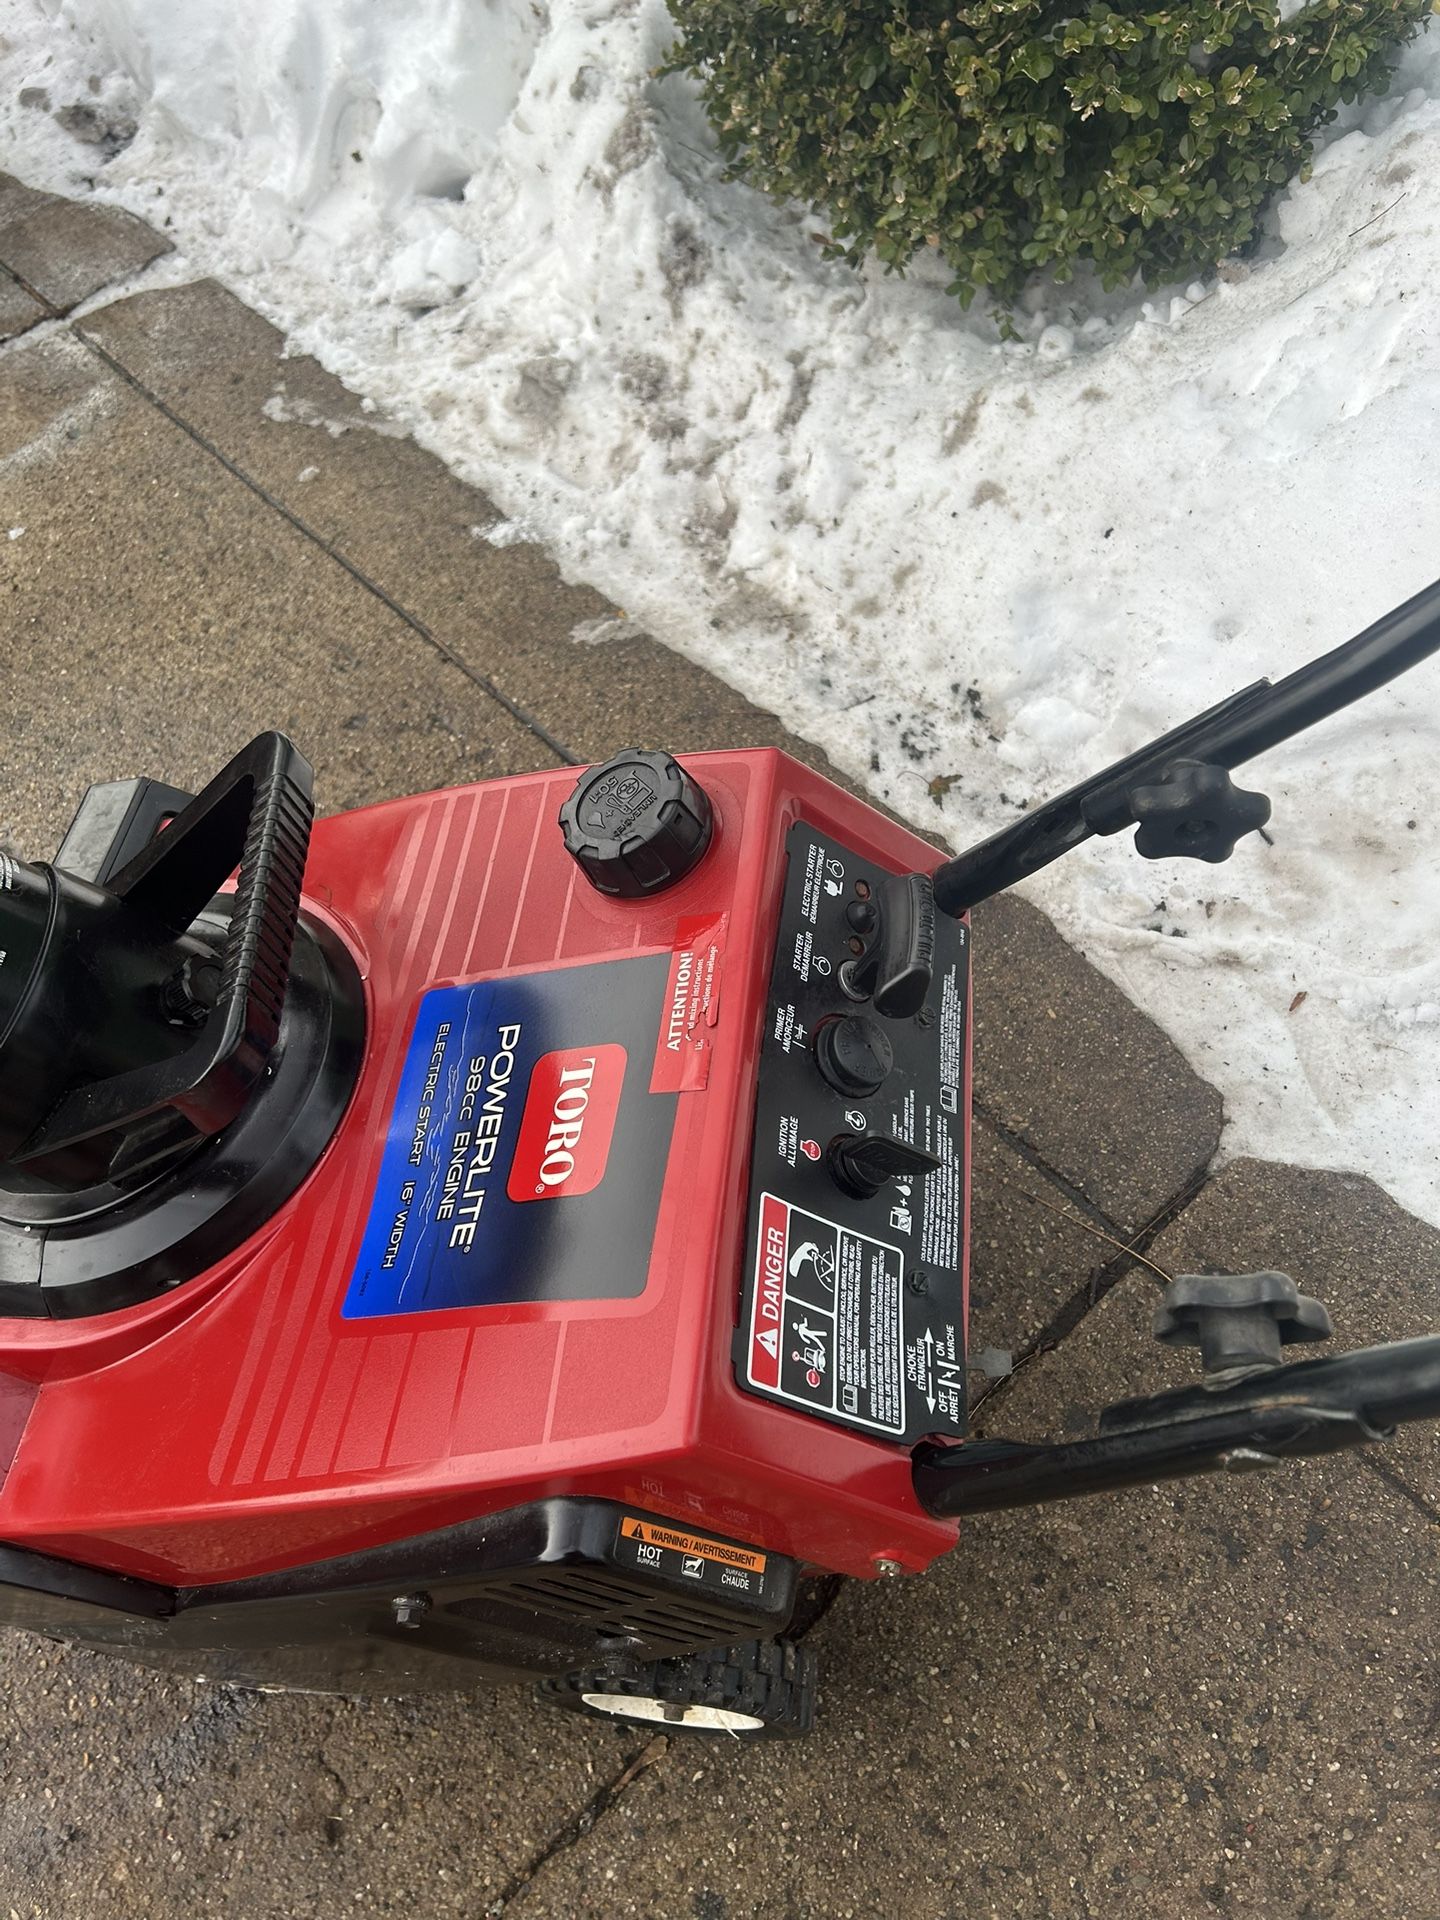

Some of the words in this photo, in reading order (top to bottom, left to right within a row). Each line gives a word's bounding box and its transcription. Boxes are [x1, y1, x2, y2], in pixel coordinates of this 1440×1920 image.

[611, 796, 657, 841] UNLEADED
[805, 841, 816, 880] STARTER
[813, 844, 825, 887] ÉLECTRIQUE
[801, 876, 812, 918] ELECTRIC
[809, 881, 820, 926] DÉMARREUR
[707, 945, 718, 973] mélange
[793, 931, 804, 972] STARTER
[799, 928, 813, 983] DÉMARREUR
[693, 958, 704, 996] instructions
[706, 973, 713, 984] de
[667, 951, 694, 1051] ATTENTION!
[690, 993, 700, 1021] mixing
[774, 1005, 785, 1041] PRIMER
[782, 1001, 795, 1054] AMORCEUR
[420, 1022, 450, 1102] ELECTRIC
[409, 1105, 430, 1166] START
[778, 1115, 789, 1157] IGNITION
[786, 1114, 798, 1168] ALLUMAGE
[437, 1131, 470, 1221] ENGINE
[381, 1210, 408, 1270] WIDTH
[761, 1225, 784, 1321] DANGER
[841, 1257, 847, 1266] OR
[847, 1282, 853, 1290] AT
[839, 1336, 845, 1344] TO
[846, 1352, 852, 1362] DO
[935, 1339, 945, 1357] ON
[946, 1323, 954, 1361] MARCHE
[859, 1347, 867, 1388] INSTRUCTIONS.
[906, 1343, 916, 1382] CHOKE
[916, 1336, 926, 1391] ÉTRANGLEUR
[938, 1390, 947, 1413] OFF
[947, 1387, 958, 1424] ARRÊT
[636, 1556, 661, 1569] SURFACE
[637, 1543, 663, 1562] HOT
[651, 1528, 688, 1548] WARNING
[693, 1541, 757, 1567] AVERTISSEMENT
[721, 1574, 750, 1590] CHAUDE
[725, 1567, 748, 1579] SURFACE
